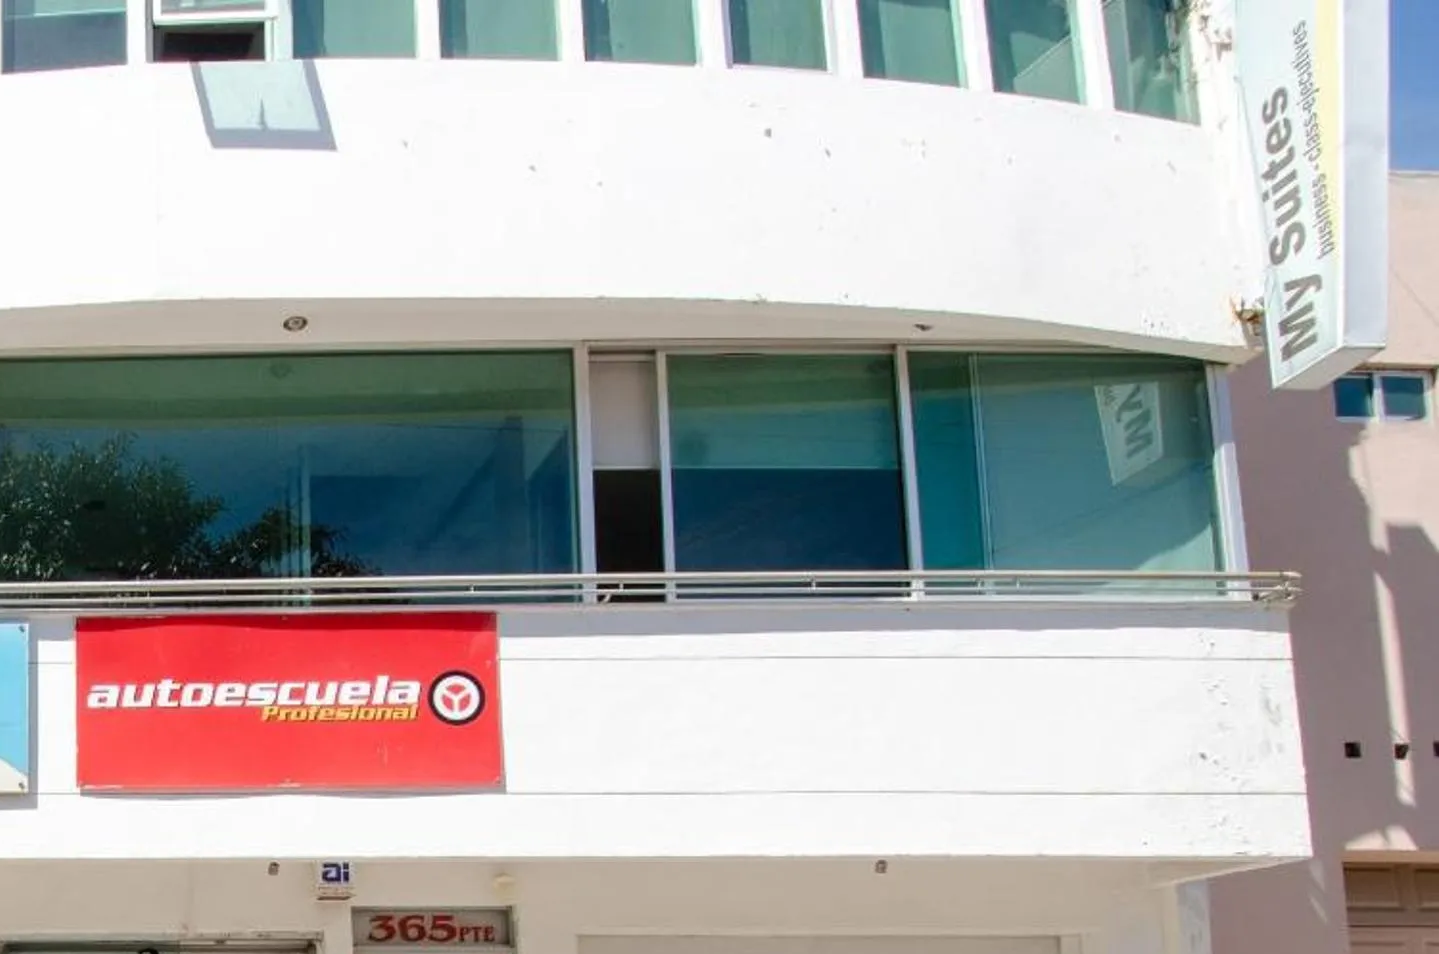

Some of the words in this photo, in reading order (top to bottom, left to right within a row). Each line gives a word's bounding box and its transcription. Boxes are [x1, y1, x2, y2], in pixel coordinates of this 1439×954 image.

[1261, 87, 1306, 266] Suites
[1313, 173, 1335, 260] business
[1278, 274, 1322, 362] My
[86, 675, 422, 709] autoescuela
[261, 704, 420, 722] Profesional
